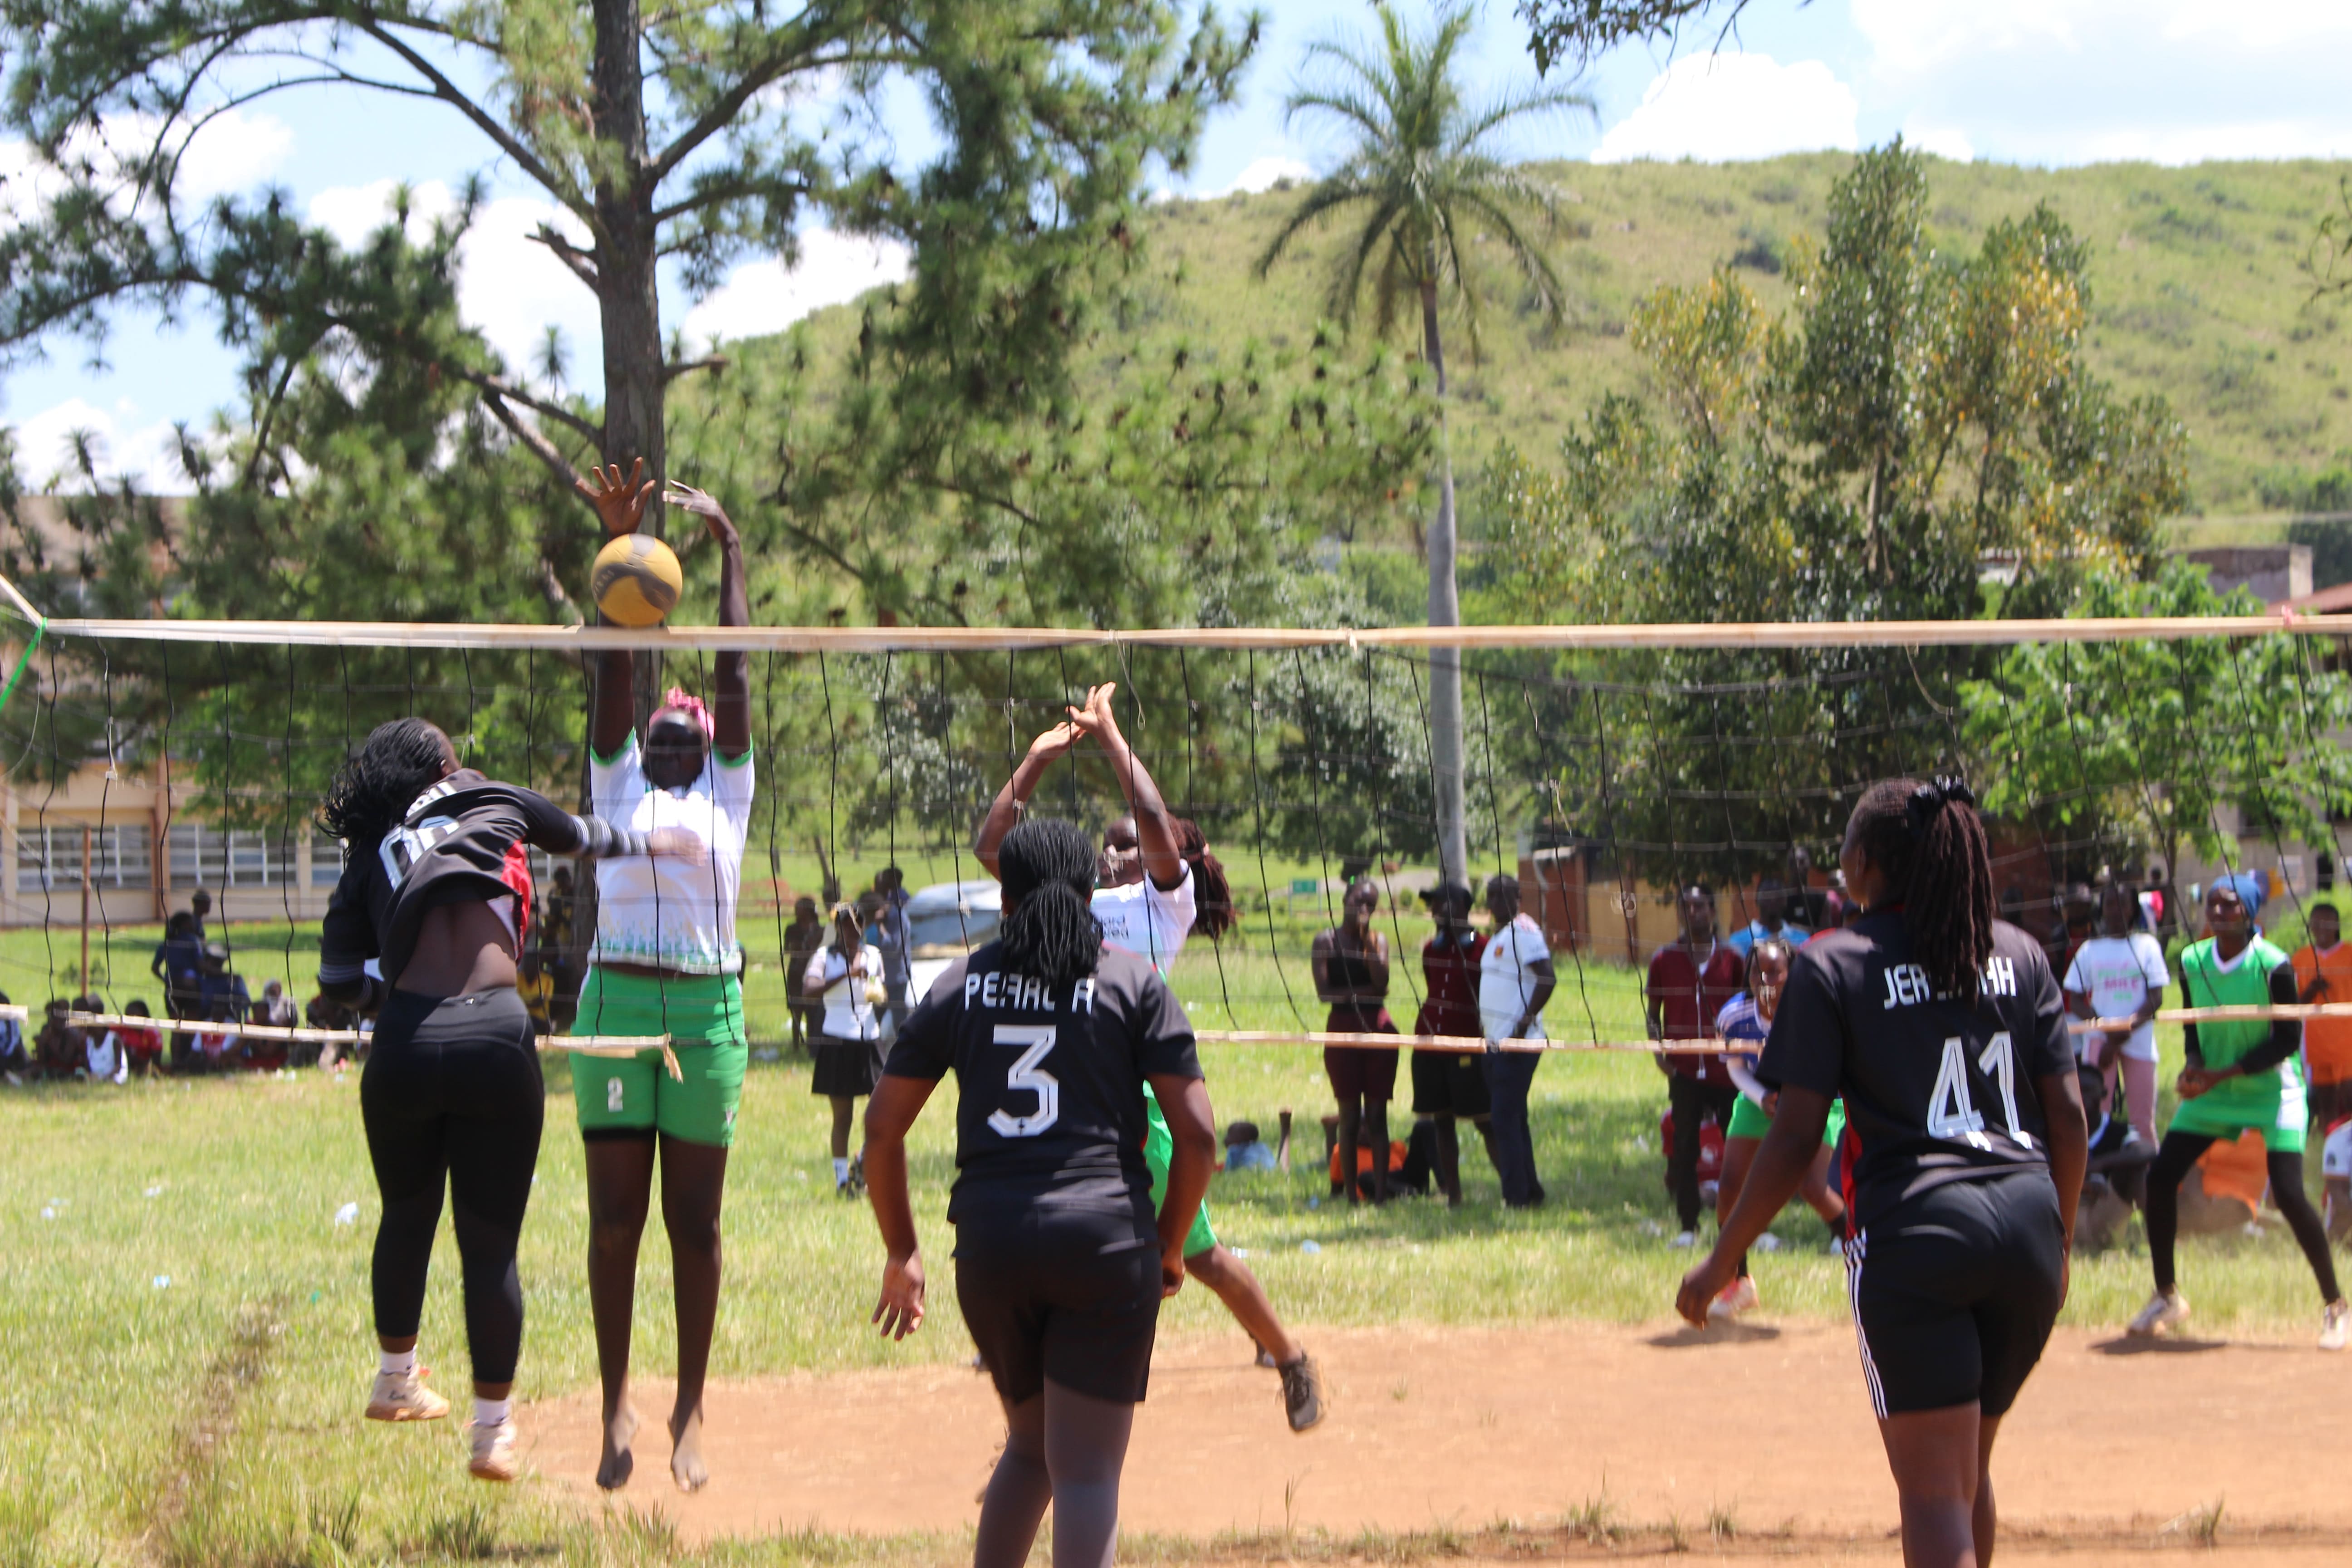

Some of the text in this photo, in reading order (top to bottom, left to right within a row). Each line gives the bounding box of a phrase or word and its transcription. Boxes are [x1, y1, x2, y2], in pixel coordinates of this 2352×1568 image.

[1884, 957, 2016, 1009] JERAH
[608, 1076, 623, 1112] 2
[988, 1024, 1058, 1138] 3
[1927, 1030, 2033, 1152] 41
